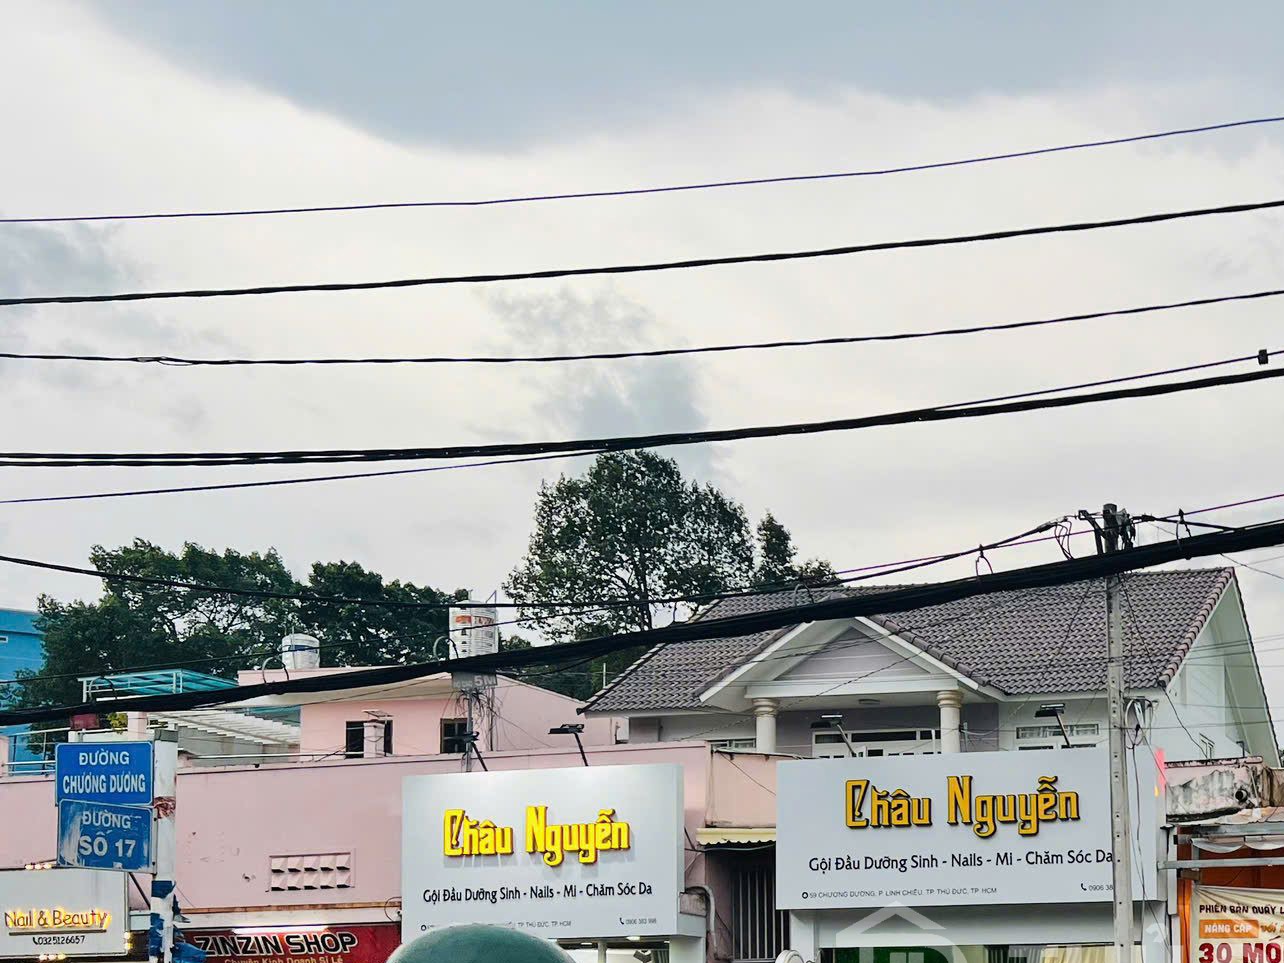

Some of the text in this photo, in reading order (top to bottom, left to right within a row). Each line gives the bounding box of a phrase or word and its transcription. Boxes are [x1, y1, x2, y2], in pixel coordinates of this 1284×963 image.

[79, 748, 130, 766] ĐƯỜNG
[62, 770, 146, 793] CHƯƠNG DƯƠNG
[82, 809, 131, 829] ĐƯỜNG
[844, 775, 1081, 839] Châu Nguyễn
[79, 829, 136, 857] SỐ 17
[443, 804, 632, 867] Châu Nguyễn
[809, 849, 1114, 875] Gội Đầu Dưỡng Sinh Nails Mi Chăm Sóc Da
[423, 881, 652, 905] Gội Đầu Dưỡng Sinh Nails Mi Chăm Sóc Da
[4, 908, 110, 929] Nail & Beauty
[193, 931, 358, 957] ZINZIN SHOP
